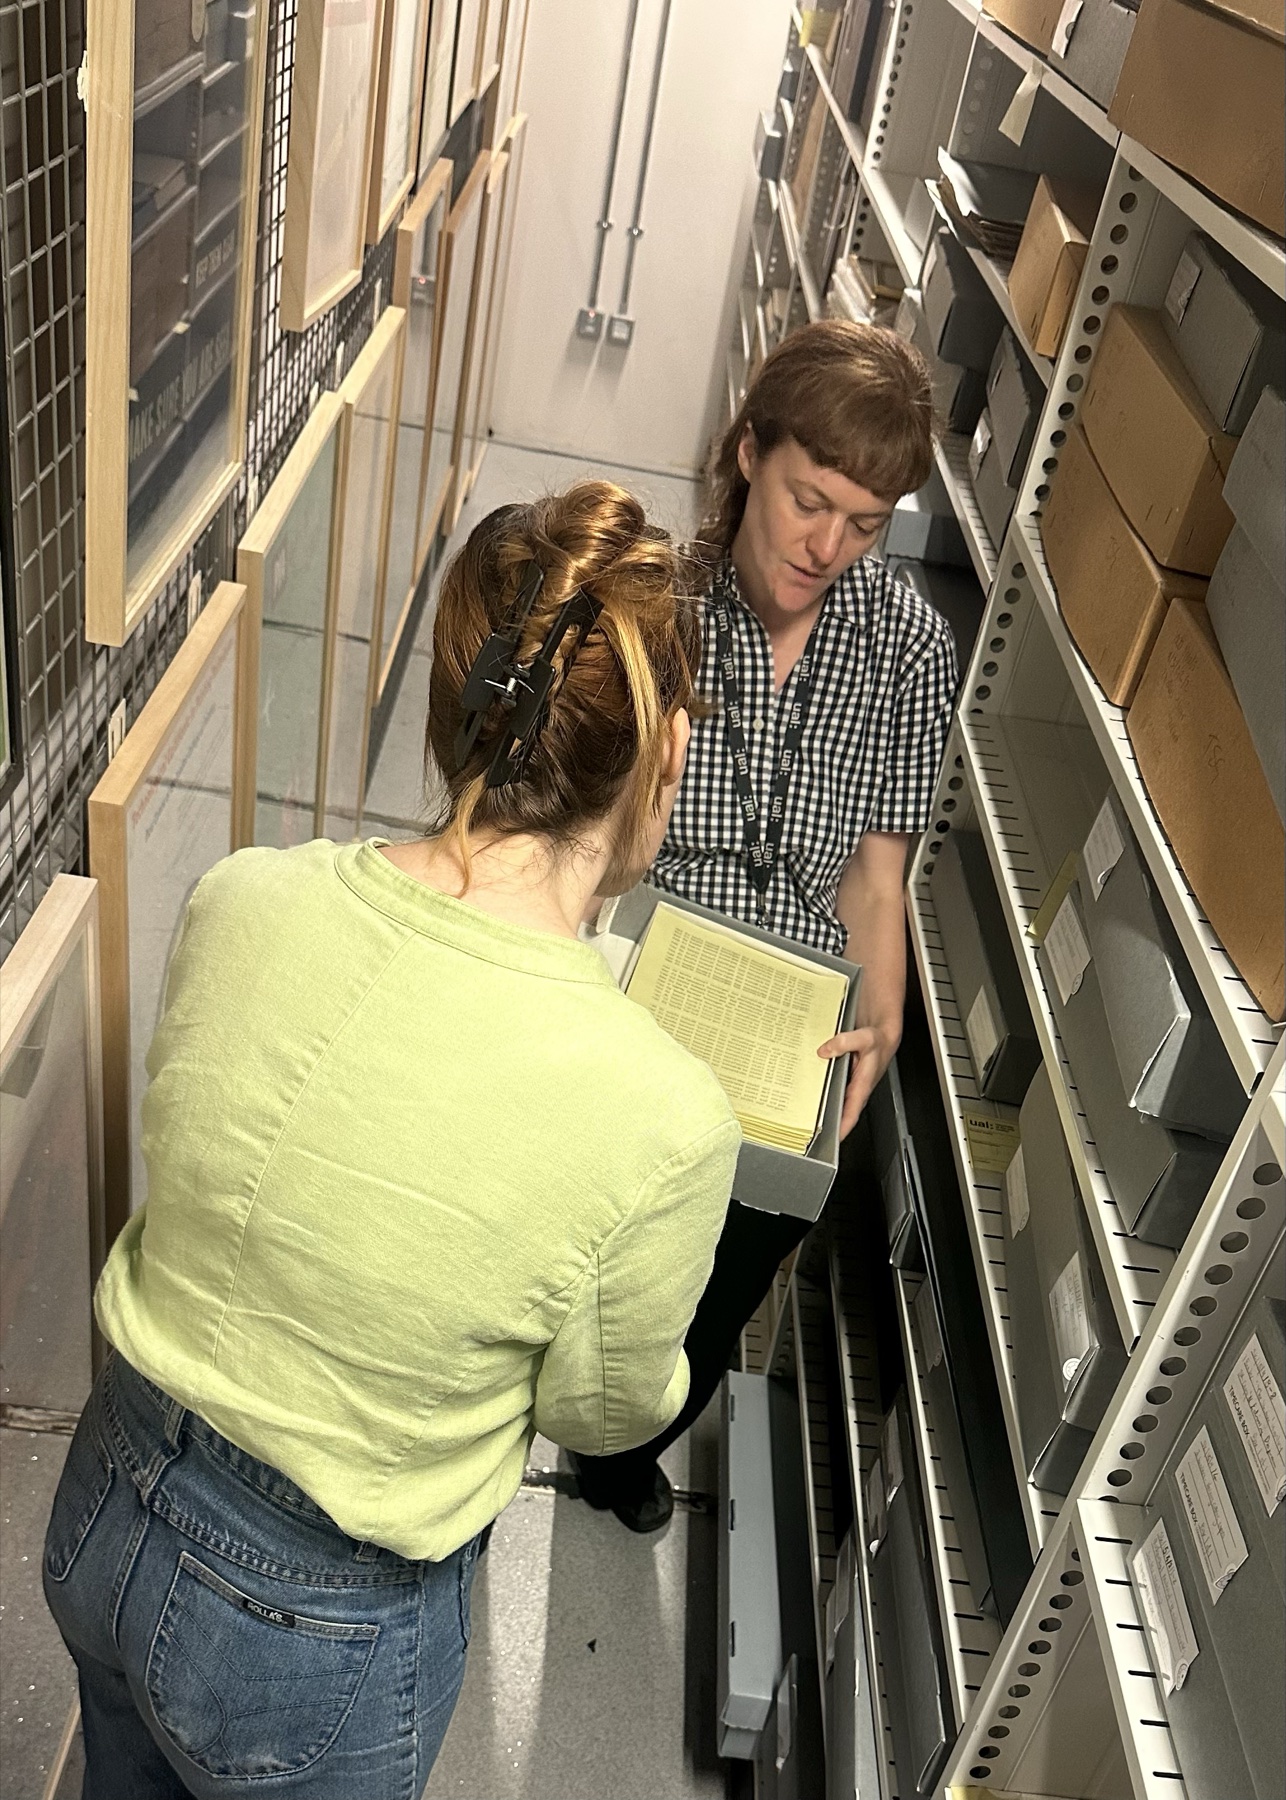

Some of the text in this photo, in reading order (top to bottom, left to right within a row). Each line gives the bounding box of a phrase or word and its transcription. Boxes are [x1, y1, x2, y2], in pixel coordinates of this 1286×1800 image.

[716, 604, 728, 632] ual:
[721, 653, 735, 681] ual:
[799, 655, 811, 682] ual:
[727, 701, 742, 728] ual:
[789, 703, 802, 729] ual:
[735, 748, 749, 775] ual:
[779, 750, 792, 776] ual:
[742, 795, 756, 822] ual:
[770, 796, 783, 822] ual:
[750, 841, 763, 867] ual:
[970, 1120, 994, 1130] ual:
[1240, 1418, 1249, 1439] BOX
[247, 1601, 283, 1622] ROLLA'S
